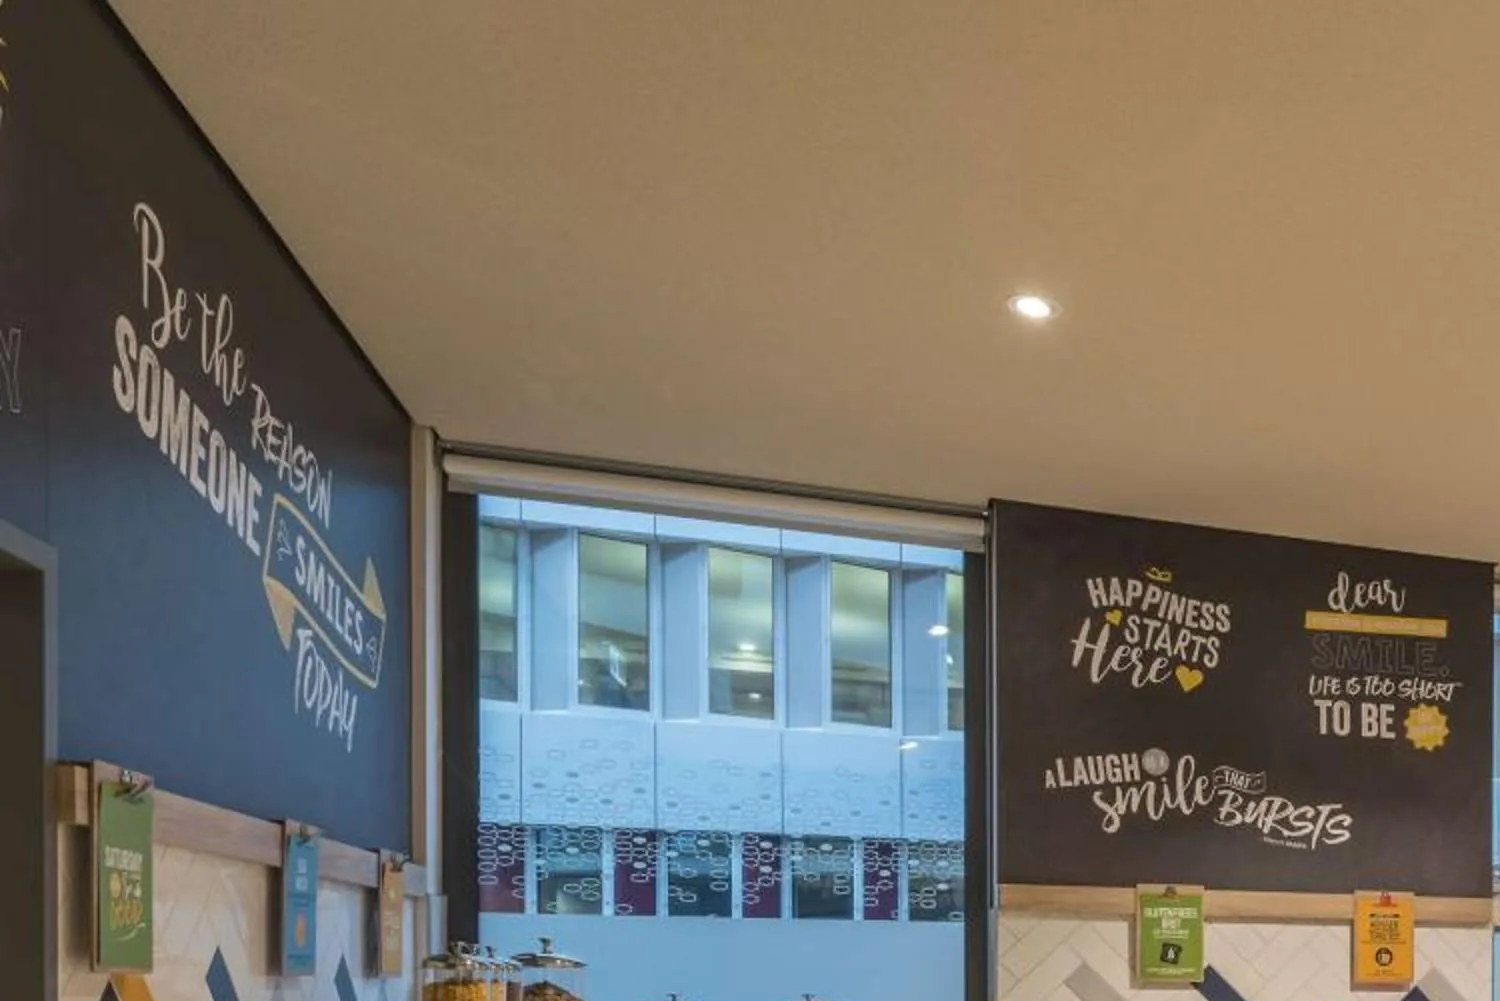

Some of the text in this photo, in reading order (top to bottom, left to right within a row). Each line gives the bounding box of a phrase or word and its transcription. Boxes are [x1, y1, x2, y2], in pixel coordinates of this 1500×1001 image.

[132, 201, 333, 529] Be the REASON
[112, 314, 263, 557] SOMEONE
[294, 534, 364, 656] SMILES
[1086, 576, 1231, 634] HAPPINESS
[1327, 571, 1406, 613] dear
[1070, 616, 1173, 689] Here
[1124, 613, 1221, 669] STARTS
[295, 628, 358, 753] TODAY
[1308, 673, 1463, 702] LIFE IS TOO SHORT
[1313, 699, 1351, 737] TO
[1361, 702, 1397, 740] BE
[1045, 769, 1057, 789] A
[1055, 752, 1142, 788] LAUGH
[1092, 755, 1216, 834] smile
[1223, 769, 1251, 789] THAT
